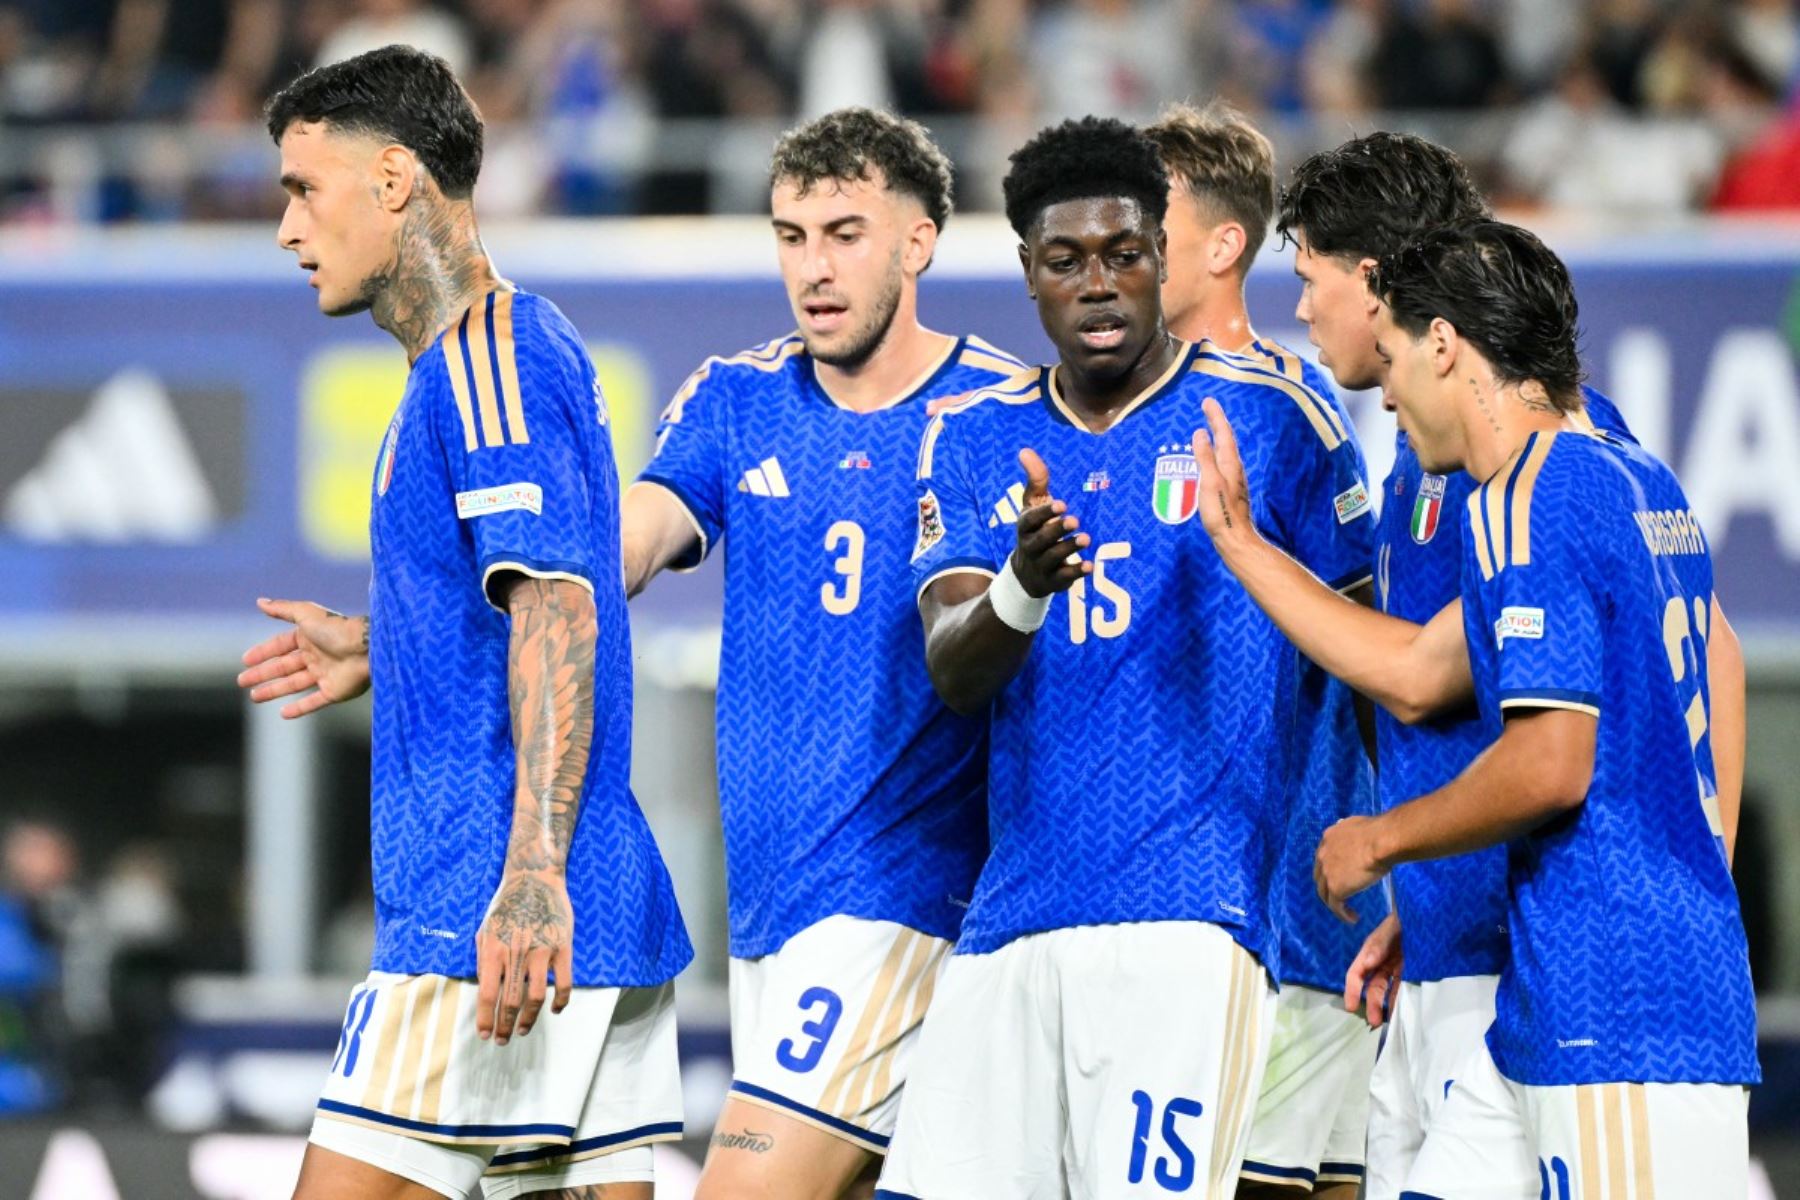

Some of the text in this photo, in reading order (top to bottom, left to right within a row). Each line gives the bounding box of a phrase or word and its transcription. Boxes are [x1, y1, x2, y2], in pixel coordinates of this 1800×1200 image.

[1159, 460, 1198, 473] ITALIA
[821, 520, 865, 616] 3
[1066, 541, 1132, 645] 15
[776, 986, 843, 1074] 3
[1127, 1089, 1204, 1192] 15
